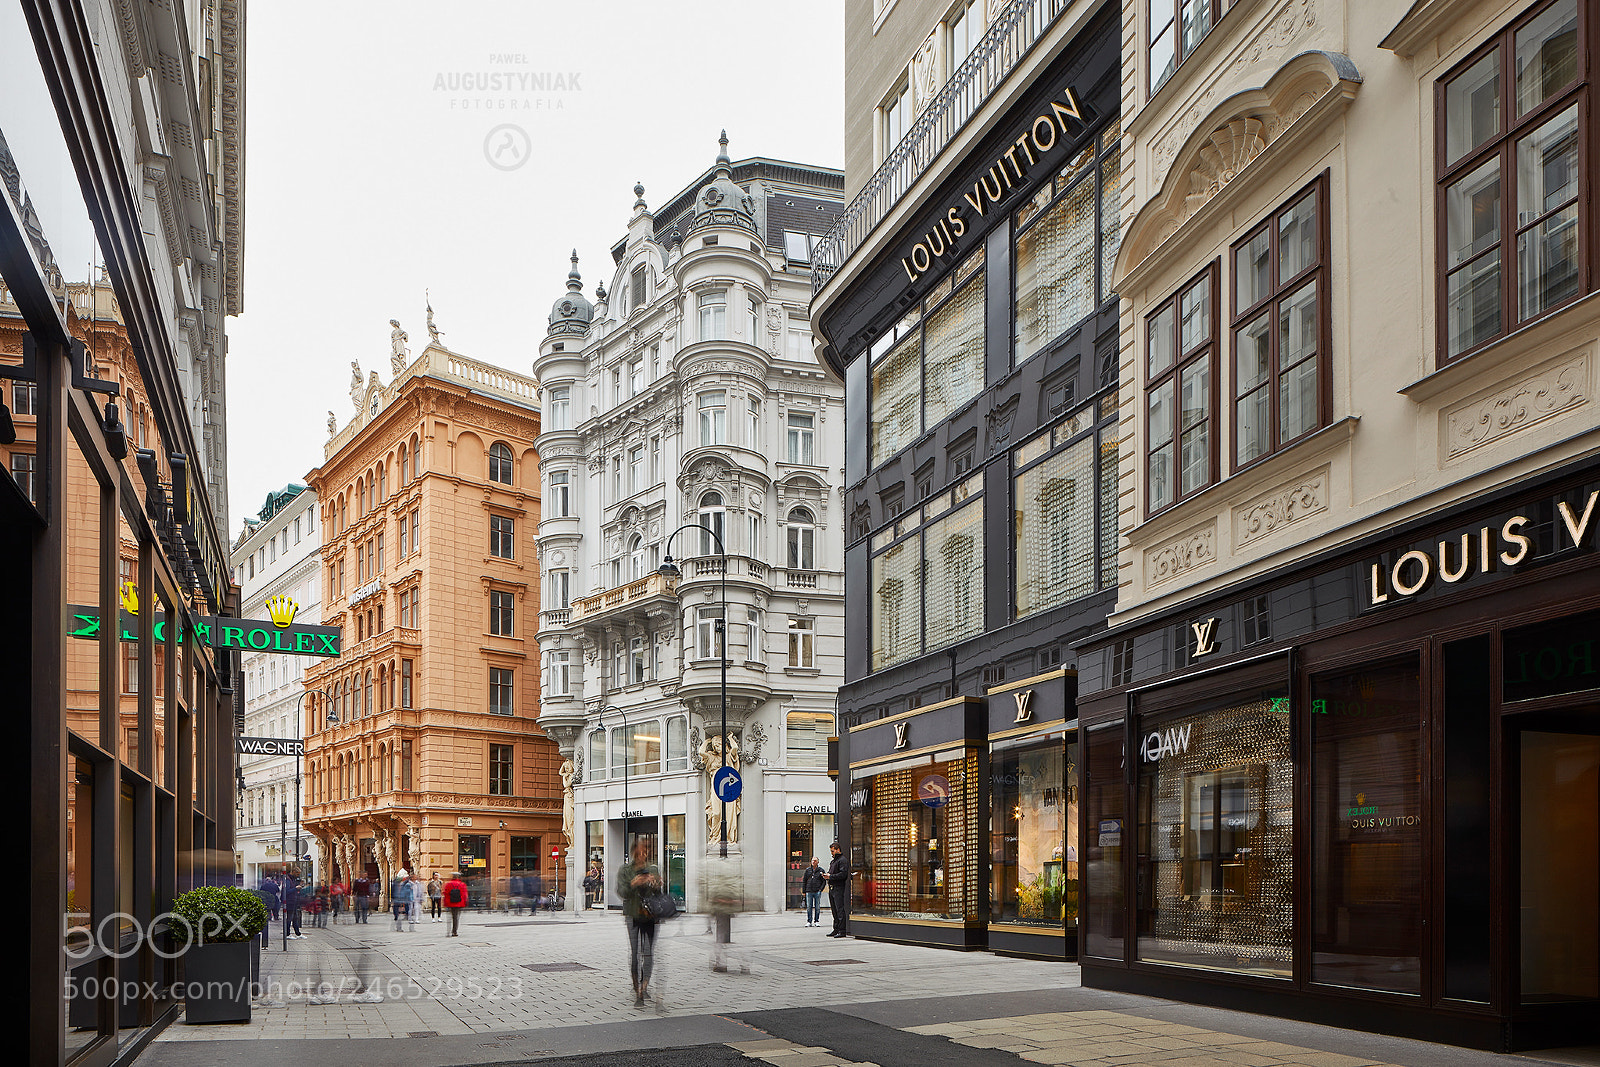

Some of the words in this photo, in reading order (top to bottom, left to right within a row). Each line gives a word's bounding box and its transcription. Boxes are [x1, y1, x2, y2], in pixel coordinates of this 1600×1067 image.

[901, 207, 966, 283] LOUIS
[964, 87, 1085, 217] VUITTON
[1371, 515, 1532, 605] LOUIS
[1556, 490, 1600, 549] V
[221, 625, 341, 656] ROLEX
[239, 739, 304, 756] WAGNER
[793, 805, 832, 813] CHANEL
